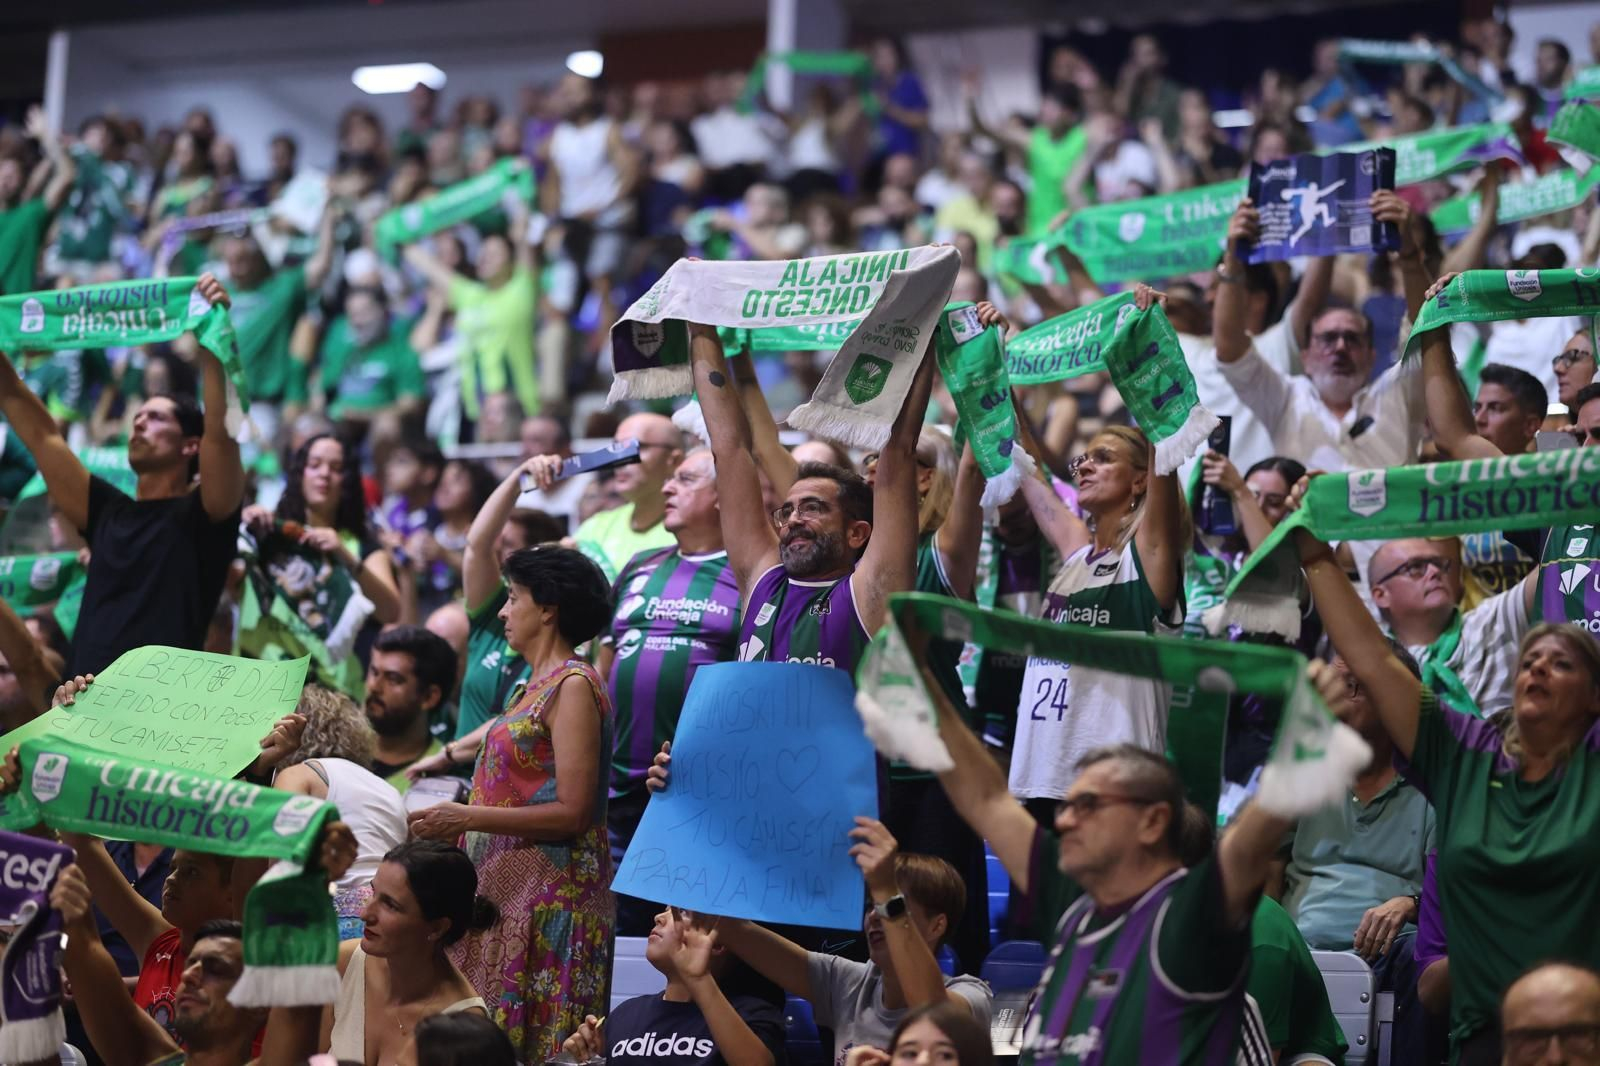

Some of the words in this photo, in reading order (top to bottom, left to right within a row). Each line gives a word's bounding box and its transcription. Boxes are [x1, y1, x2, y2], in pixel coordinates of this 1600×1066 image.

[61, 304, 167, 340] Unicaja
[644, 608, 701, 625] Unicaja
[648, 596, 729, 616] Fundación
[115, 688, 170, 714] PIDO
[169, 701, 211, 722] CON
[1030, 677, 1069, 722] 24
[109, 724, 230, 755] CAMISETA
[100, 756, 261, 813] Unicaja
[84, 785, 250, 843] histórico
[667, 807, 728, 848] TU
[734, 809, 849, 856] CAMISETA
[629, 847, 708, 897] PARA
[711, 863, 750, 909] LA
[759, 865, 844, 914] FINAL
[611, 1032, 714, 1058] adidas
